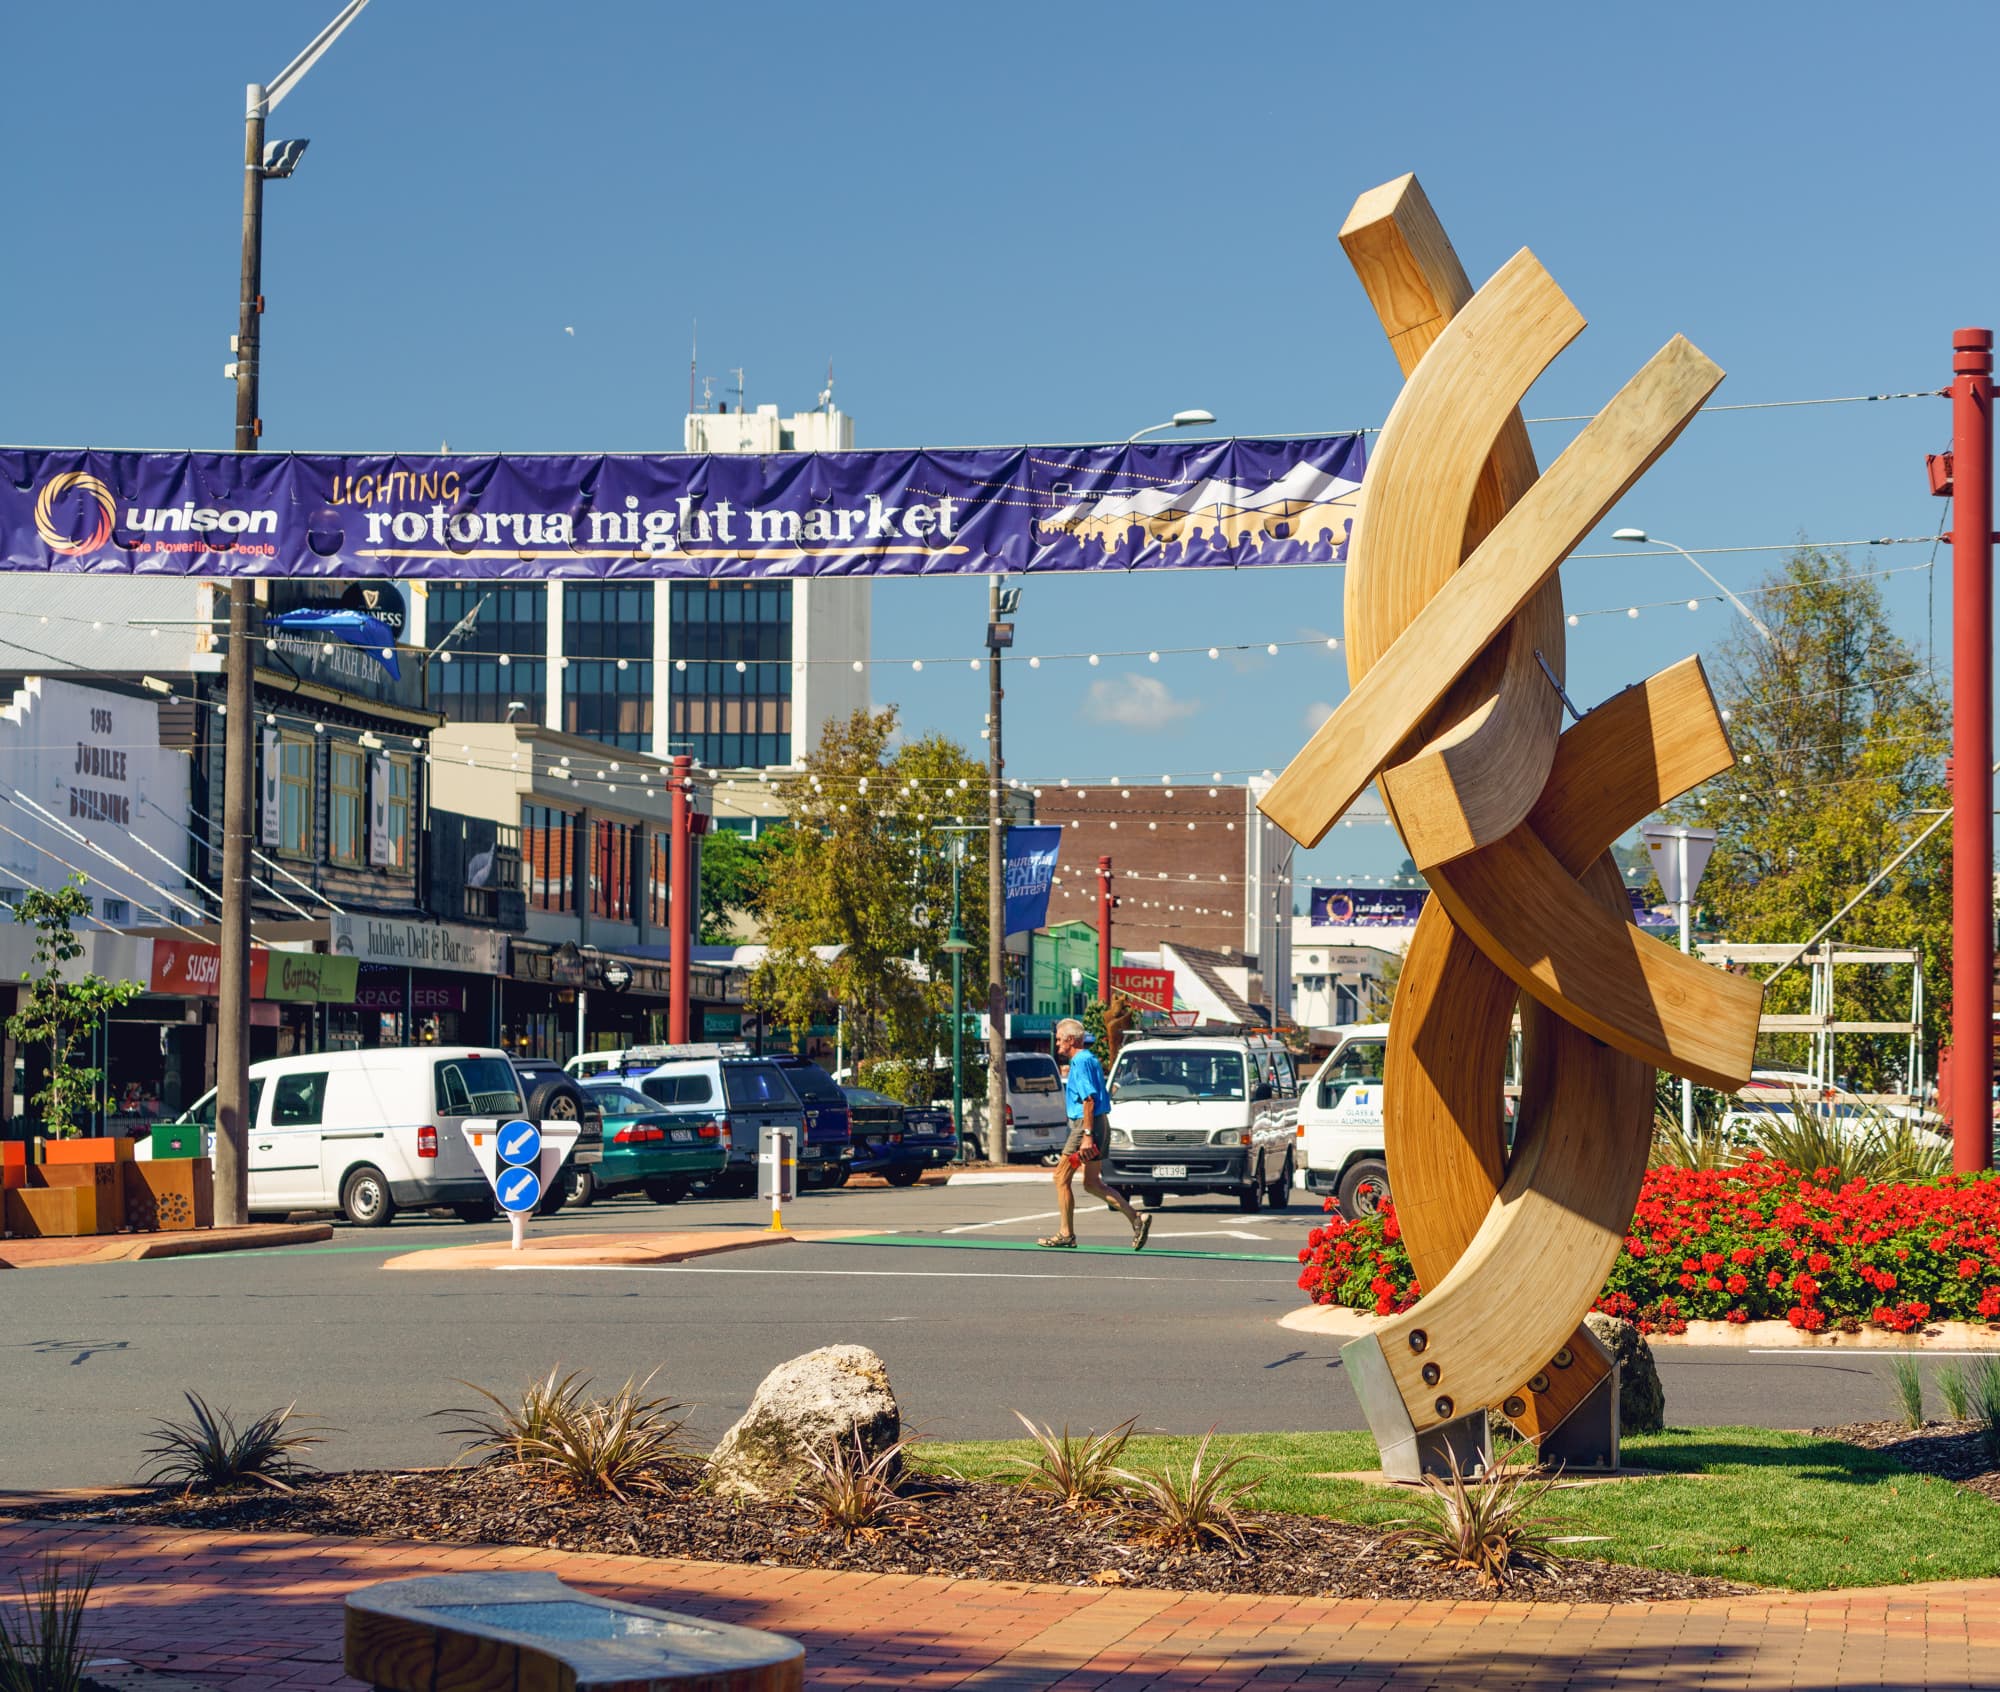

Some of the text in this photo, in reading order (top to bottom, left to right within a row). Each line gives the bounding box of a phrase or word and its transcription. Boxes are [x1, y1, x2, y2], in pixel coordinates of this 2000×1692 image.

[331, 471, 461, 508] LIGHTING
[126, 502, 278, 533] unison
[364, 492, 960, 553] rotorua night market
[128, 540, 151, 553] The
[230, 542, 275, 558] People
[331, 645, 359, 677] IRISH
[361, 655, 381, 682] BAR
[75, 742, 127, 781] JUBILEE
[70, 787, 130, 825] BUILDING
[367, 921, 405, 958] Jubilee
[406, 926, 429, 960] Deli
[431, 930, 440, 960] &
[442, 930, 461, 963] Bar
[186, 954, 219, 983] SUSHI
[1111, 974, 1166, 989] LIGHT
[355, 989, 449, 1007] KPACERS
